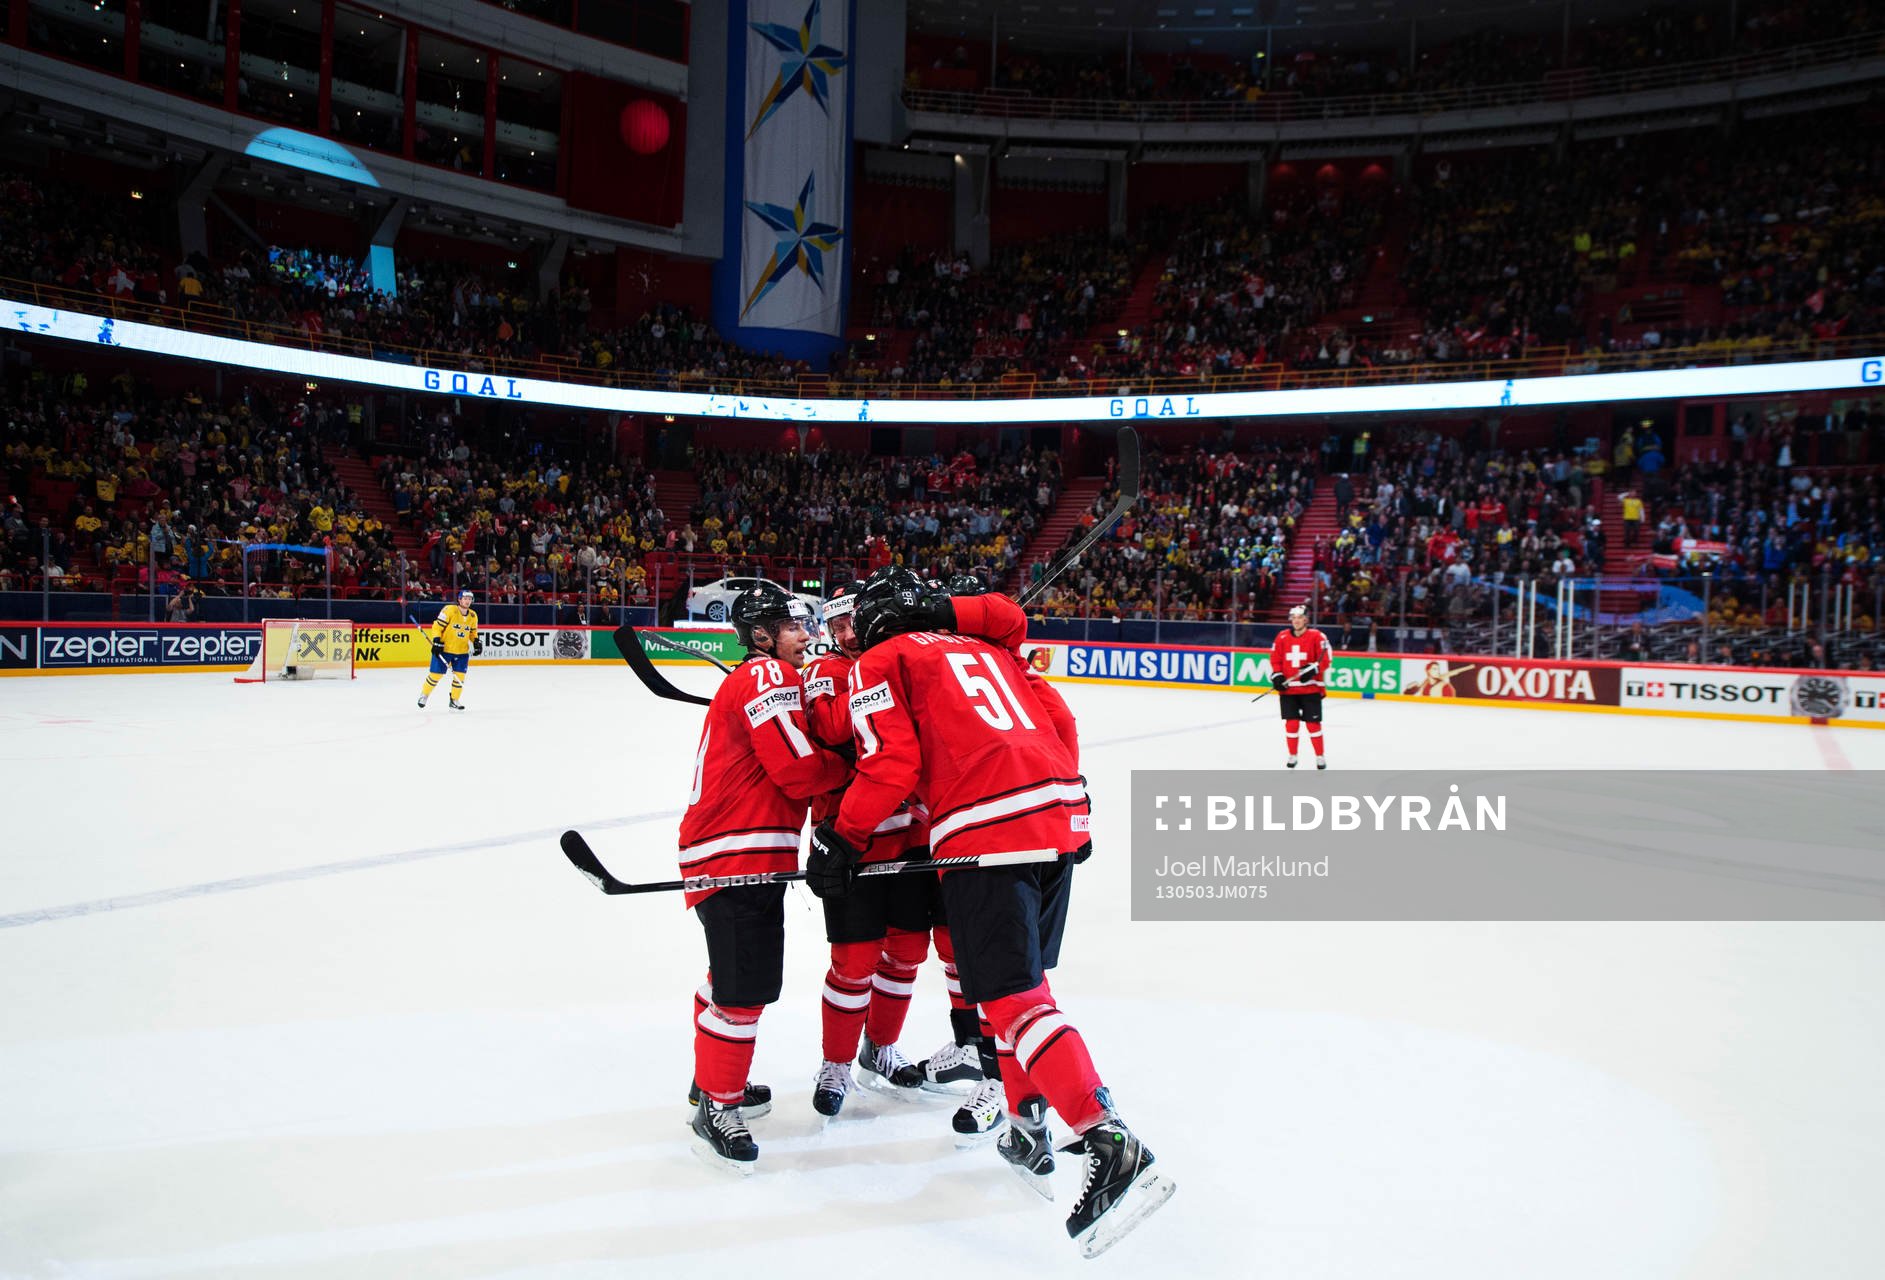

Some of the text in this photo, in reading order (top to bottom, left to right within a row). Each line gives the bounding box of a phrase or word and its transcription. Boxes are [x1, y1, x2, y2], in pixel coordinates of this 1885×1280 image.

[425, 371, 522, 397] GOAL
[1111, 398, 1199, 417] GOAL
[829, 597, 853, 609] TISSO
[49, 630, 158, 664] zepter
[166, 630, 260, 662] zepter
[332, 628, 410, 643] Raiffeisen
[332, 647, 381, 662] BANK
[1069, 647, 1229, 683] SAMSUNG
[750, 659, 784, 694] 28
[1324, 662, 1397, 691] tavis
[762, 691, 799, 706] TISSOT
[850, 686, 889, 710] ISSOT
[945, 653, 1036, 732] 51
[1669, 682, 1786, 704] TISSOT
